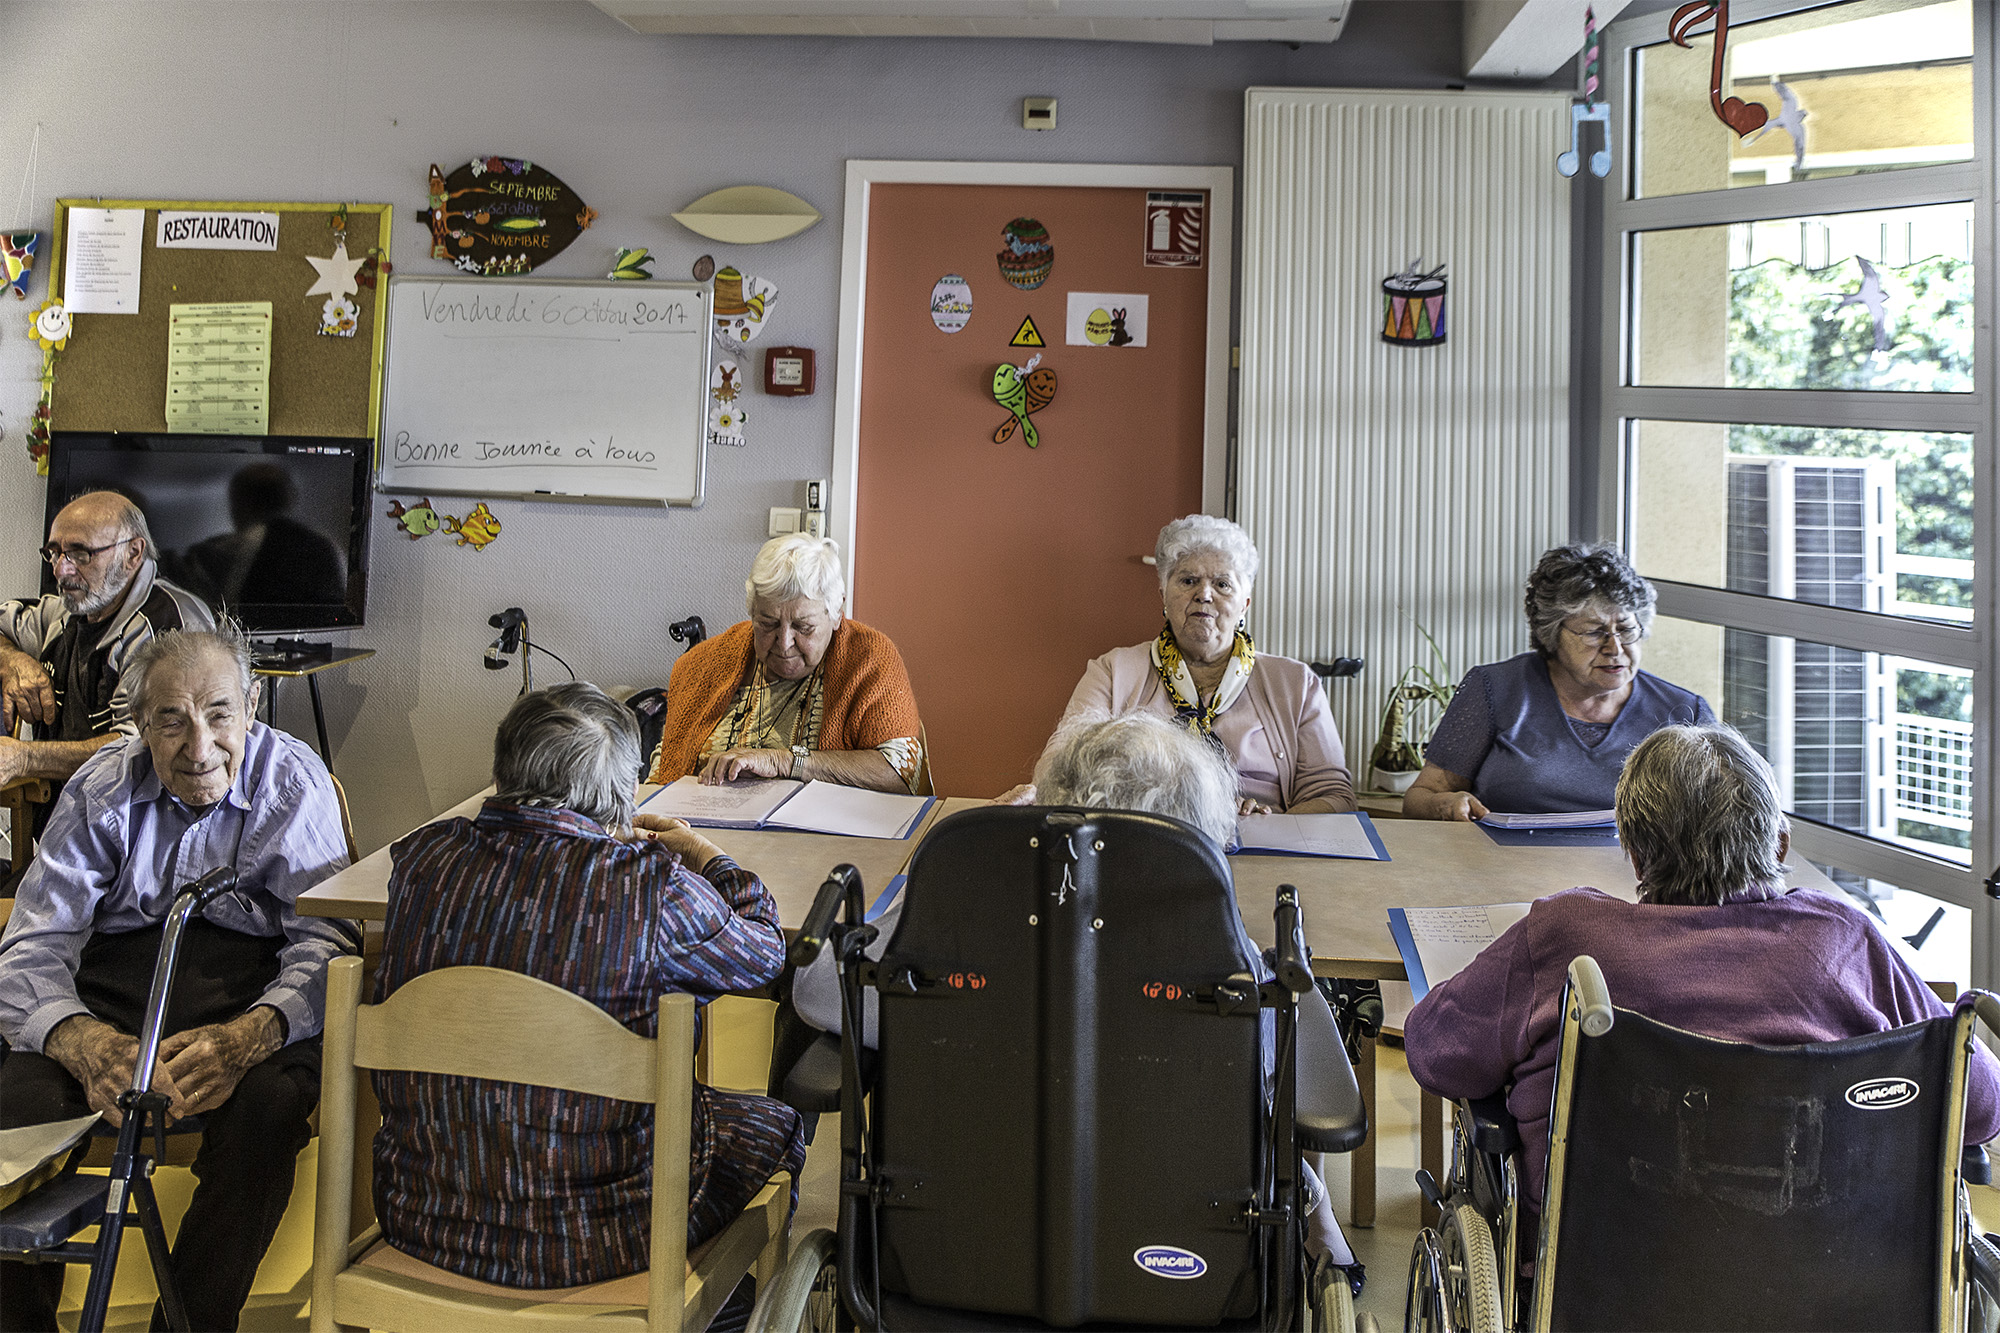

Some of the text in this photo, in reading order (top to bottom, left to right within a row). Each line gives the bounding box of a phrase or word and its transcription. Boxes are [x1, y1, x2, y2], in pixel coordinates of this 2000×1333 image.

[490, 181, 561, 201] SEPTEMBRE
[163, 217, 276, 247] RESTAURATION
[491, 233, 551, 249] NOVEMBRE
[423, 283, 534, 323] Vendredi
[543, 295, 561, 324] 6
[633, 302, 688, 326] 2017
[394, 431, 462, 463] Bonne
[575, 439, 596, 458] à
[605, 436, 656, 463] tous
[1856, 1083, 1907, 1103] INVACARE
[1144, 1256, 1194, 1268] INVACARE
